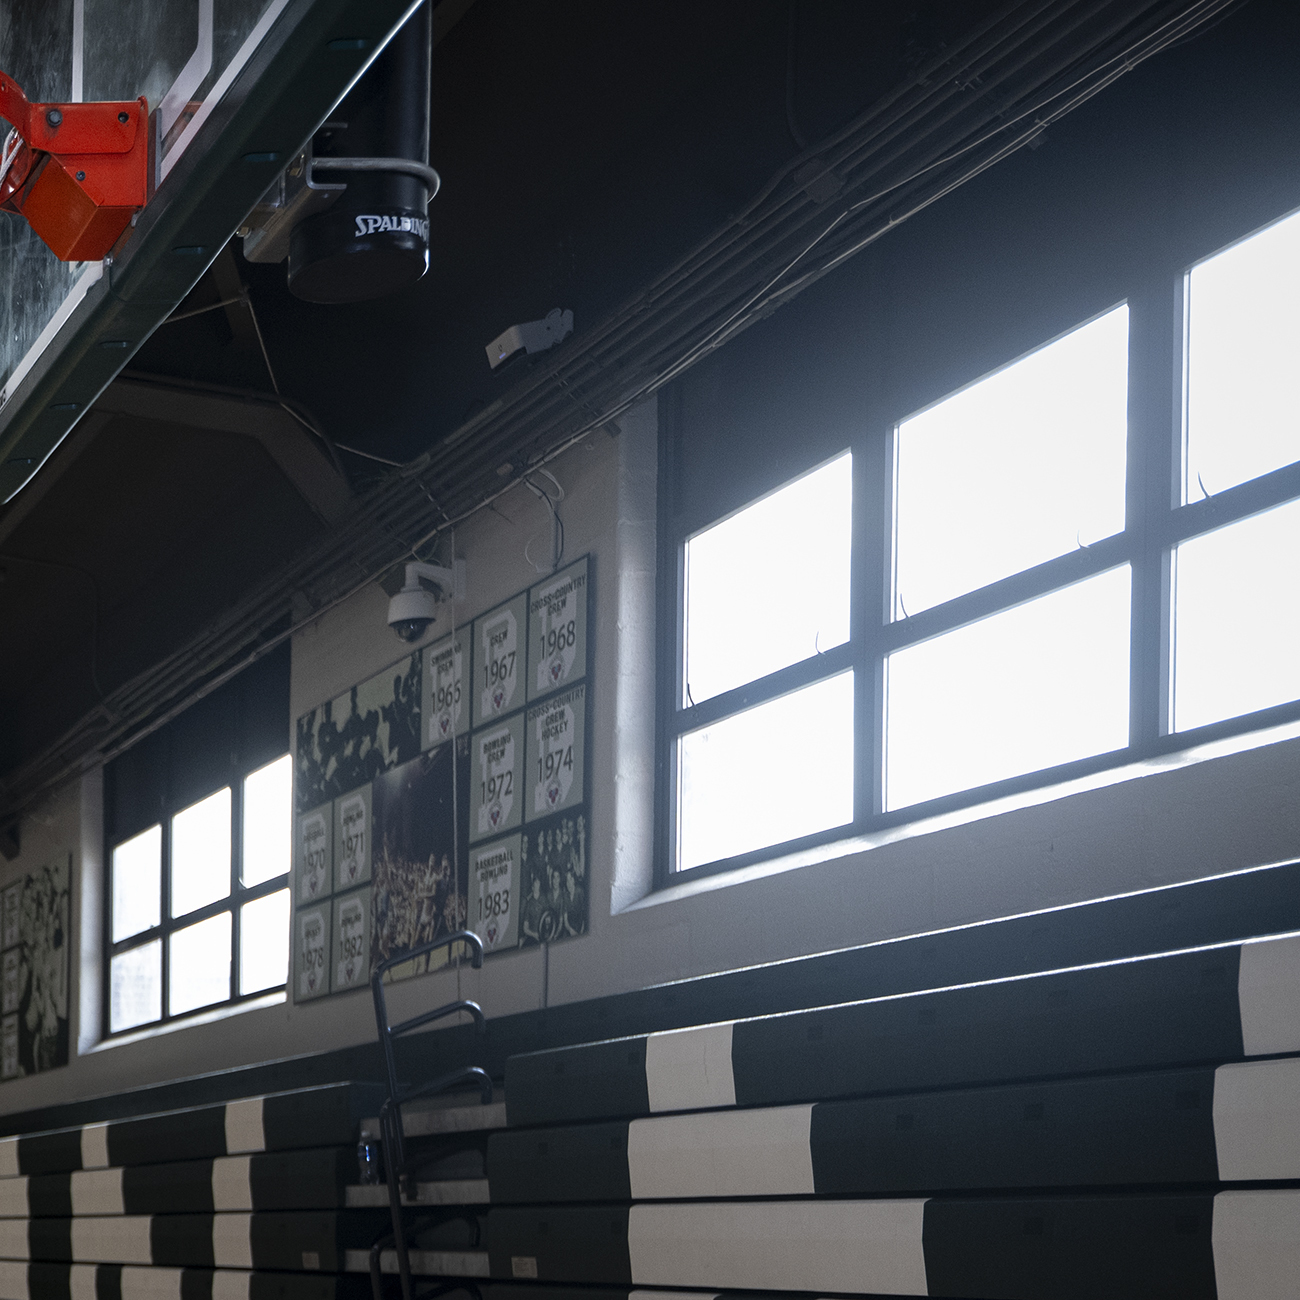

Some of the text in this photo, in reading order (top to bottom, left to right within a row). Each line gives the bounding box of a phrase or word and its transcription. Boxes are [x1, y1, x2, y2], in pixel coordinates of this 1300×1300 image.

[530, 573, 586, 614] CROSS-COUNTRY
[548, 597, 567, 616] CREW
[490, 629, 508, 647] CREW
[540, 620, 576, 660] 1968
[484, 651, 517, 689] 1967
[528, 686, 584, 721] CROSS-COUNTRY
[545, 708, 566, 727] CREW
[541, 721, 568, 741] HOCKEY
[487, 746, 506, 765] CREW
[538, 745, 573, 783] 1974
[481, 770, 513, 805] 1972
[342, 833, 363, 860] 1971
[475, 850, 514, 873] BASKETBALL
[478, 889, 510, 921] 1983
[302, 947, 324, 973] 1978
[340, 935, 363, 961] 1982
